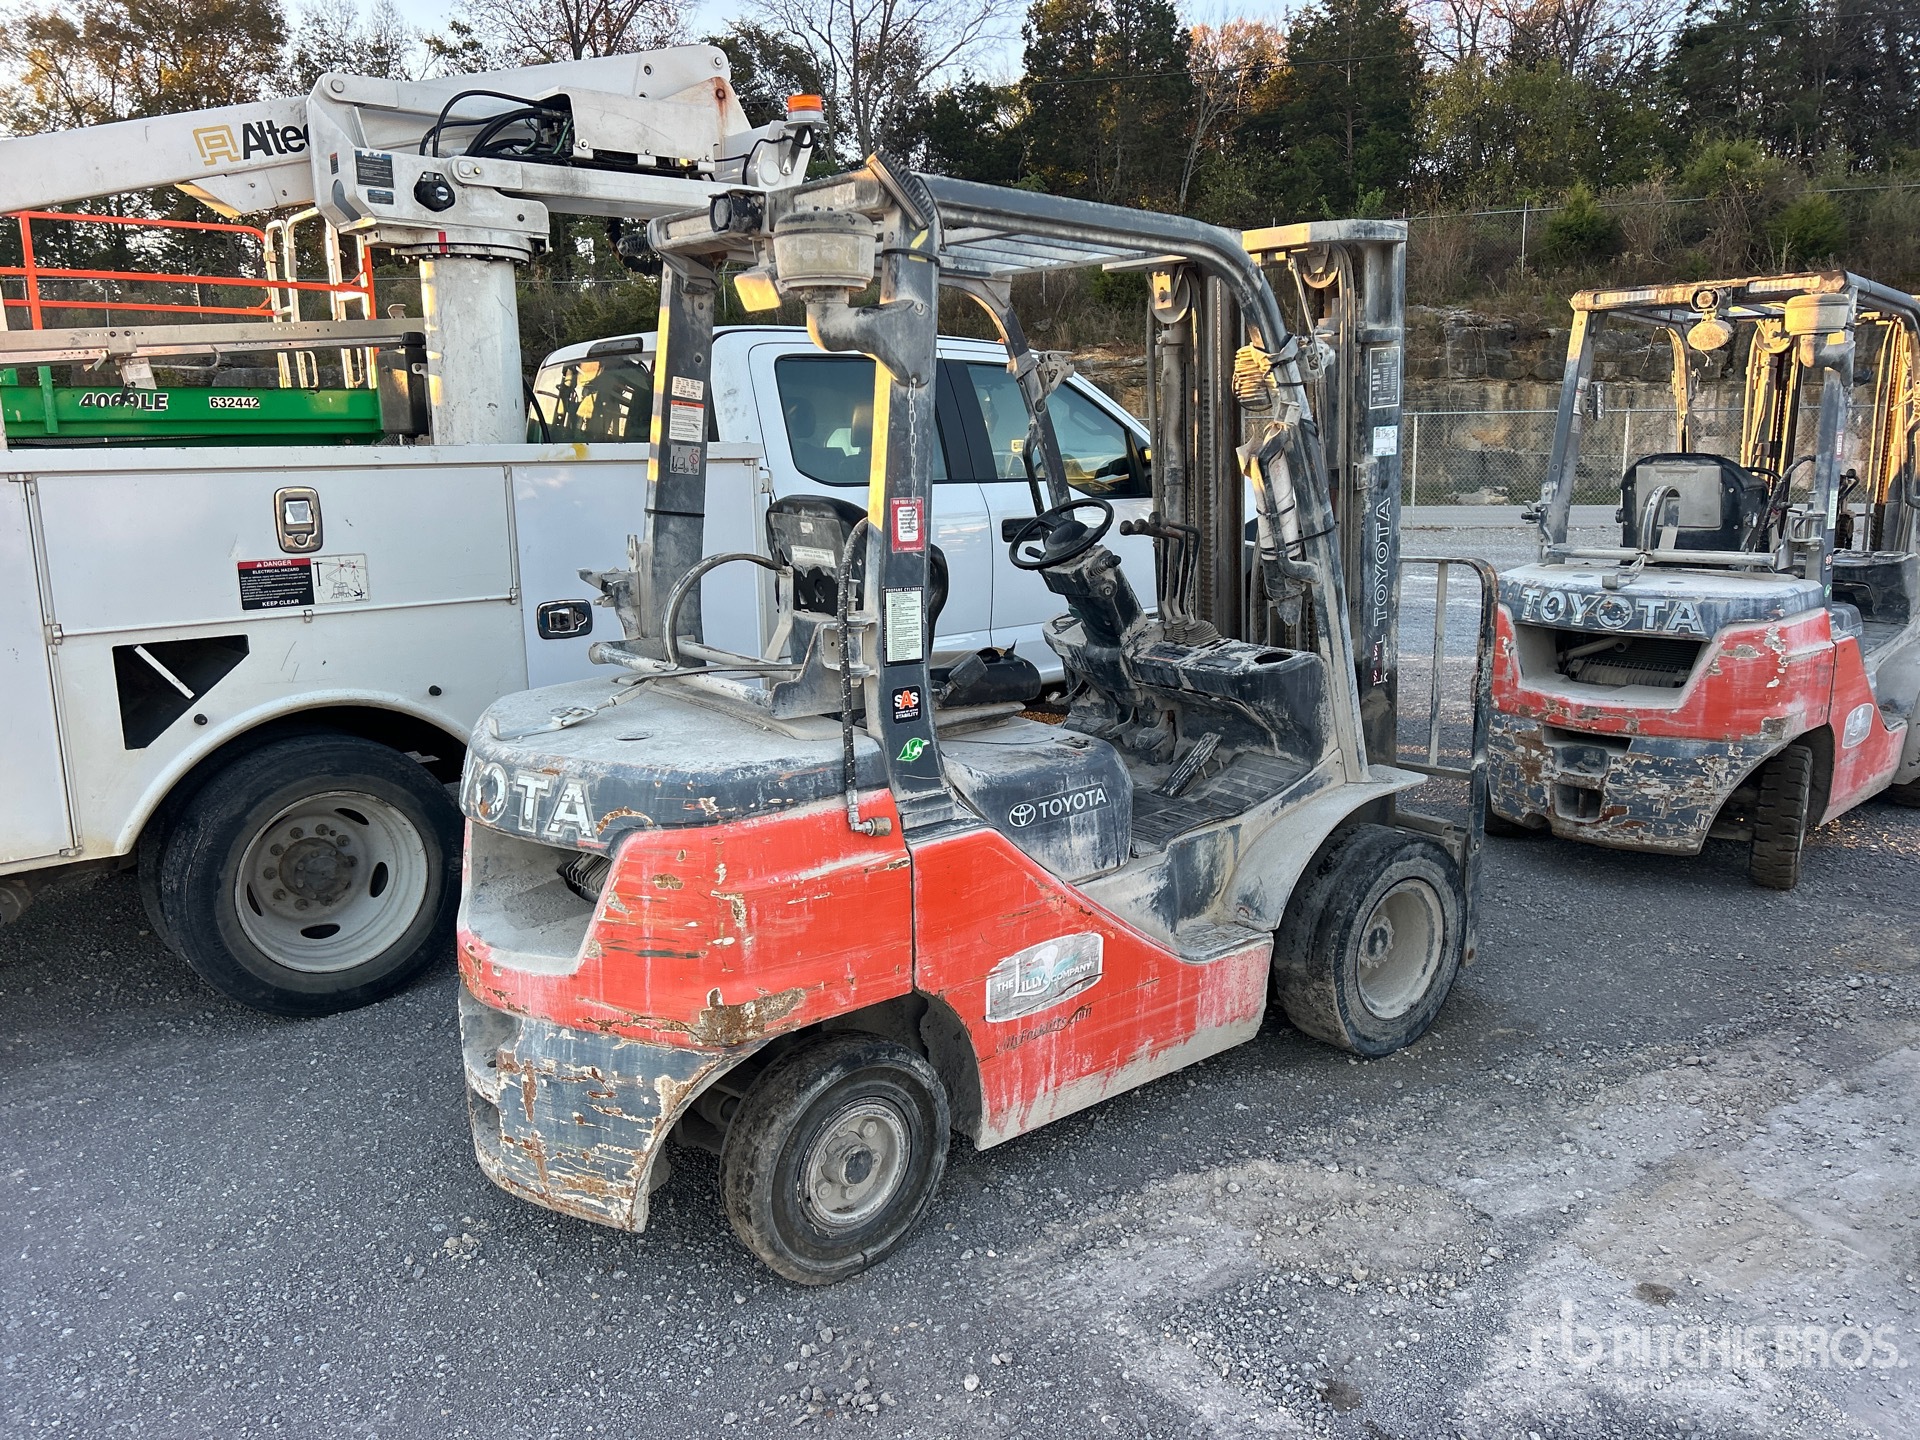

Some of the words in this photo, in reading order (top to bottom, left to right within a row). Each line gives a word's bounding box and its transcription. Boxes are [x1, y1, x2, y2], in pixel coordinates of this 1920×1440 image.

[210, 397, 260, 408] 632442
[263, 560, 292, 568] DANGER
[1374, 497, 1391, 627] TOYOTA
[1521, 587, 1706, 635] TOYOTA
[894, 690, 919, 709] SAS
[1038, 787, 1107, 818] TOYOTA
[996, 979, 1014, 993] THE
[1051, 961, 1093, 983] COMPANY
